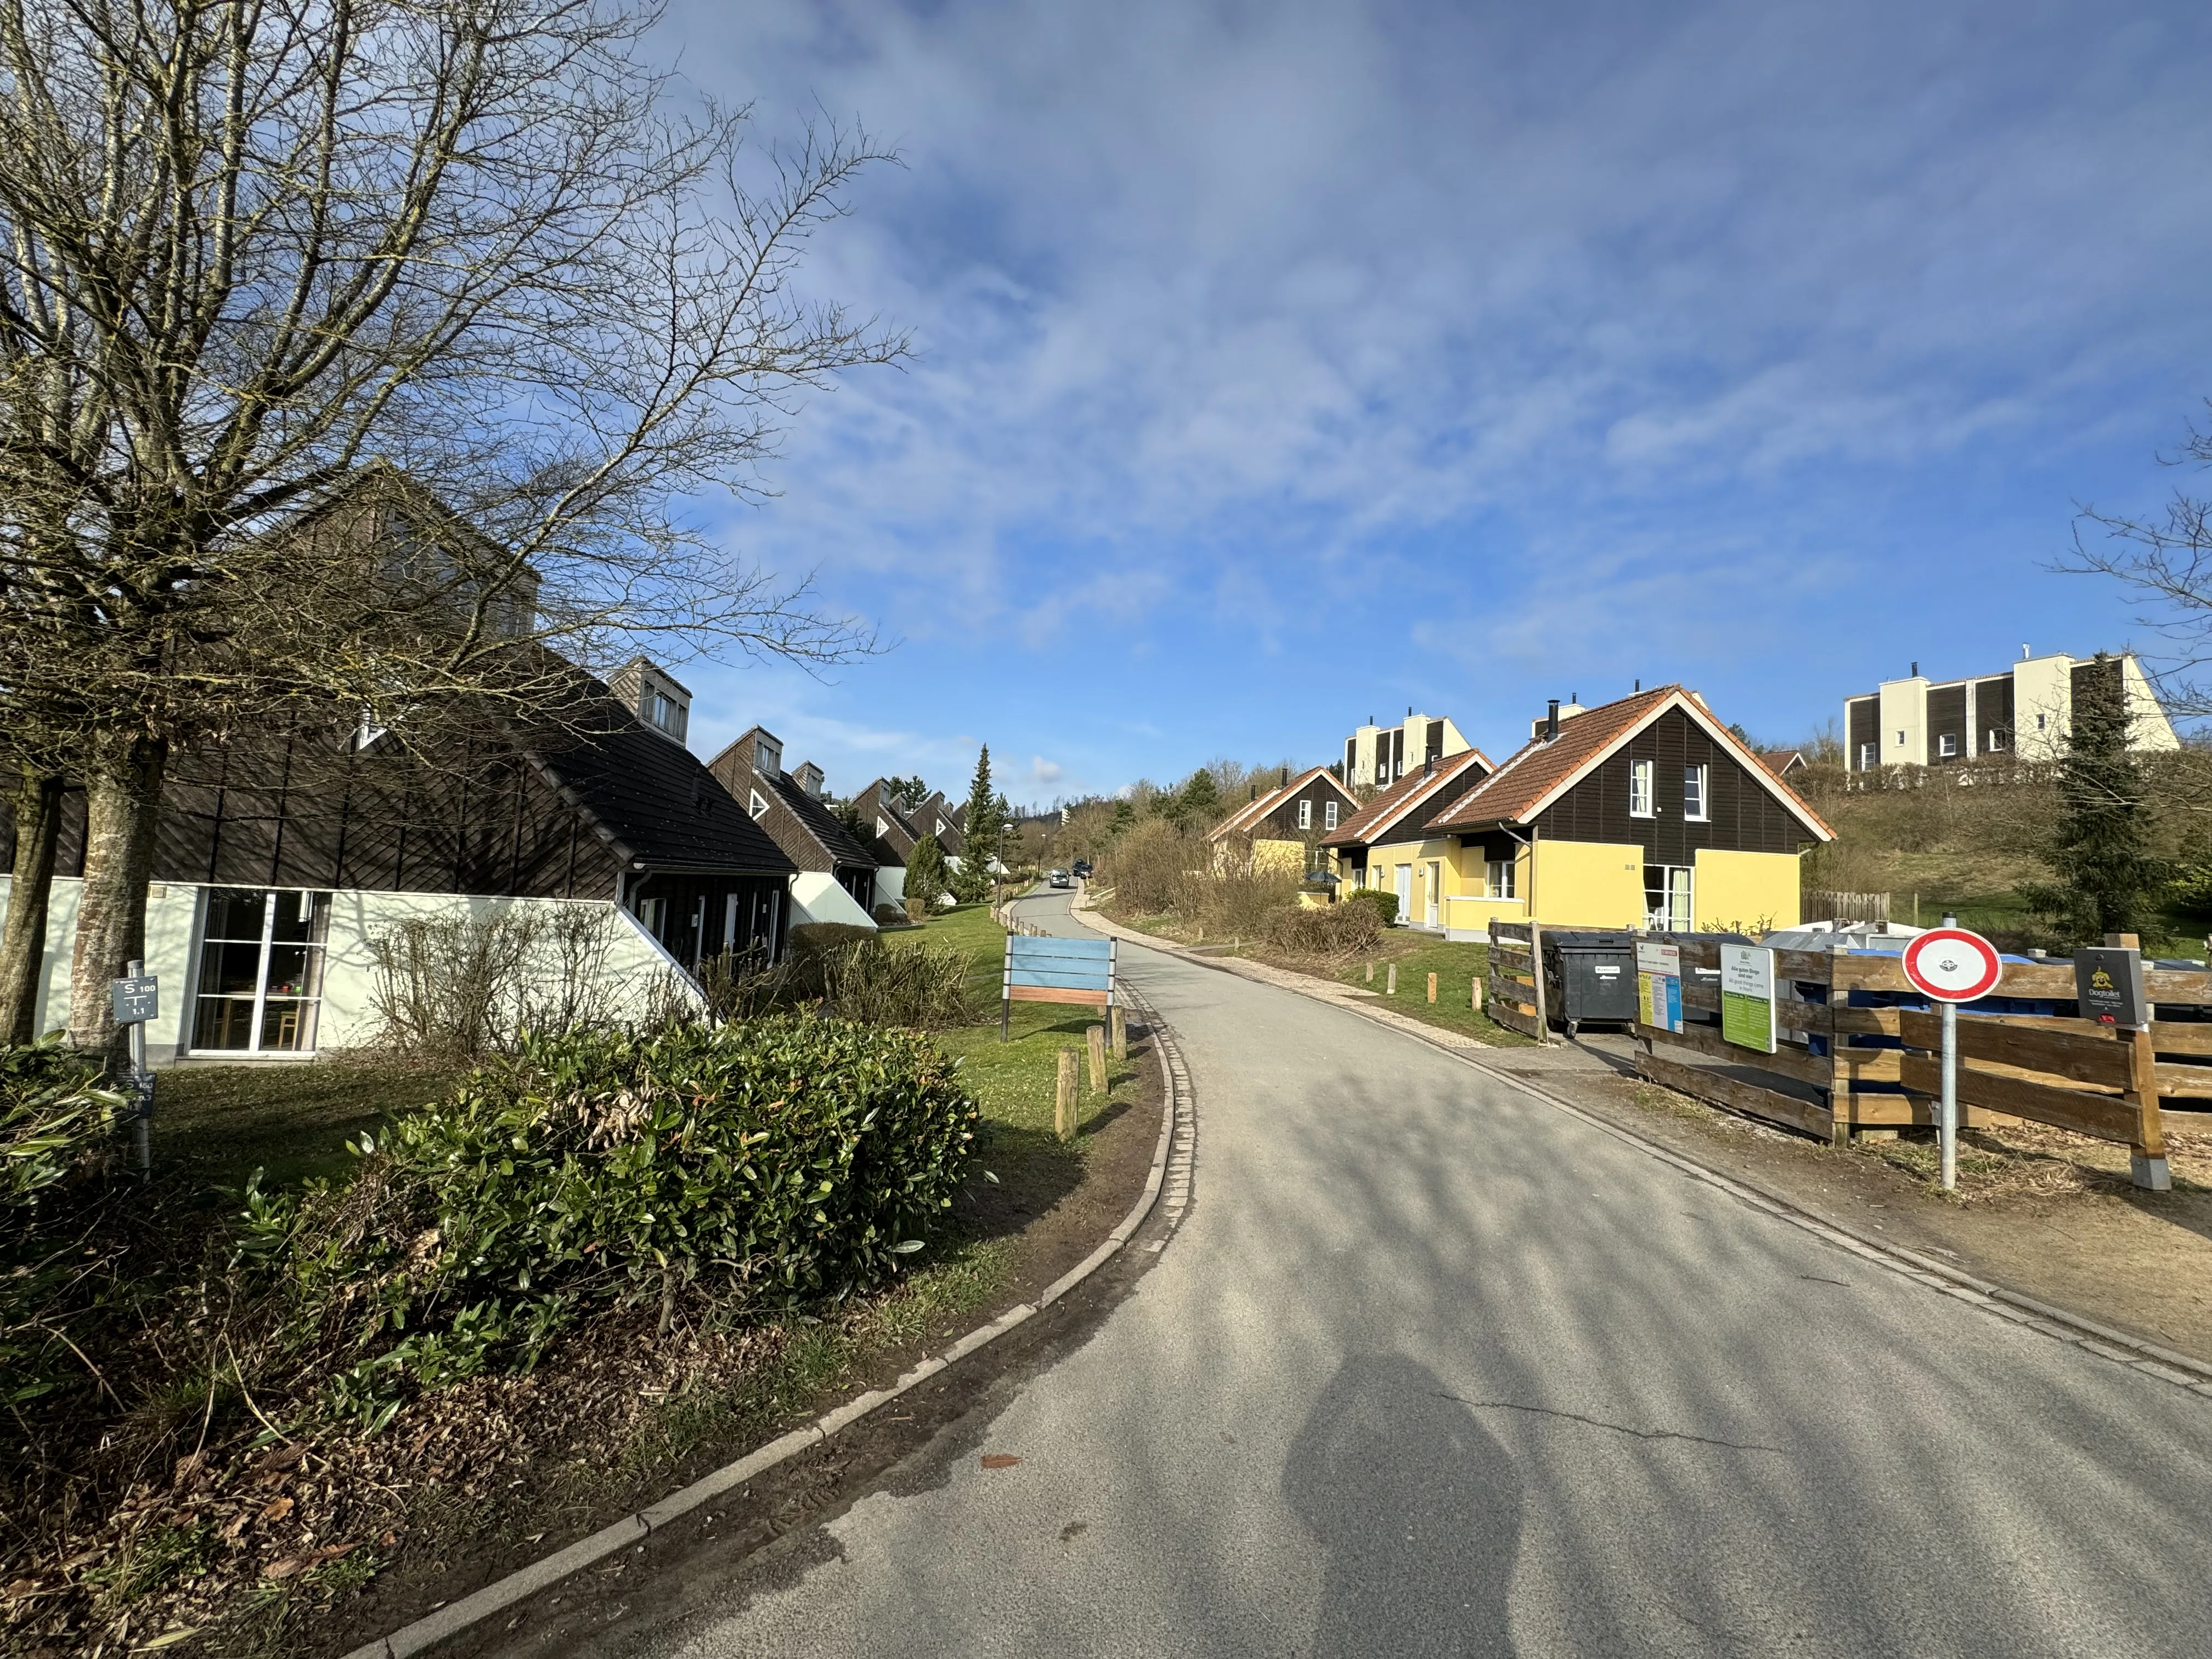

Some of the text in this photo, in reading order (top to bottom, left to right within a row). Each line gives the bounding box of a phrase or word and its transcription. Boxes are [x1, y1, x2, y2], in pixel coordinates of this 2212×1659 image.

[125, 984, 156, 994] S 100
[2089, 989, 2120, 998] Dogtoilet
